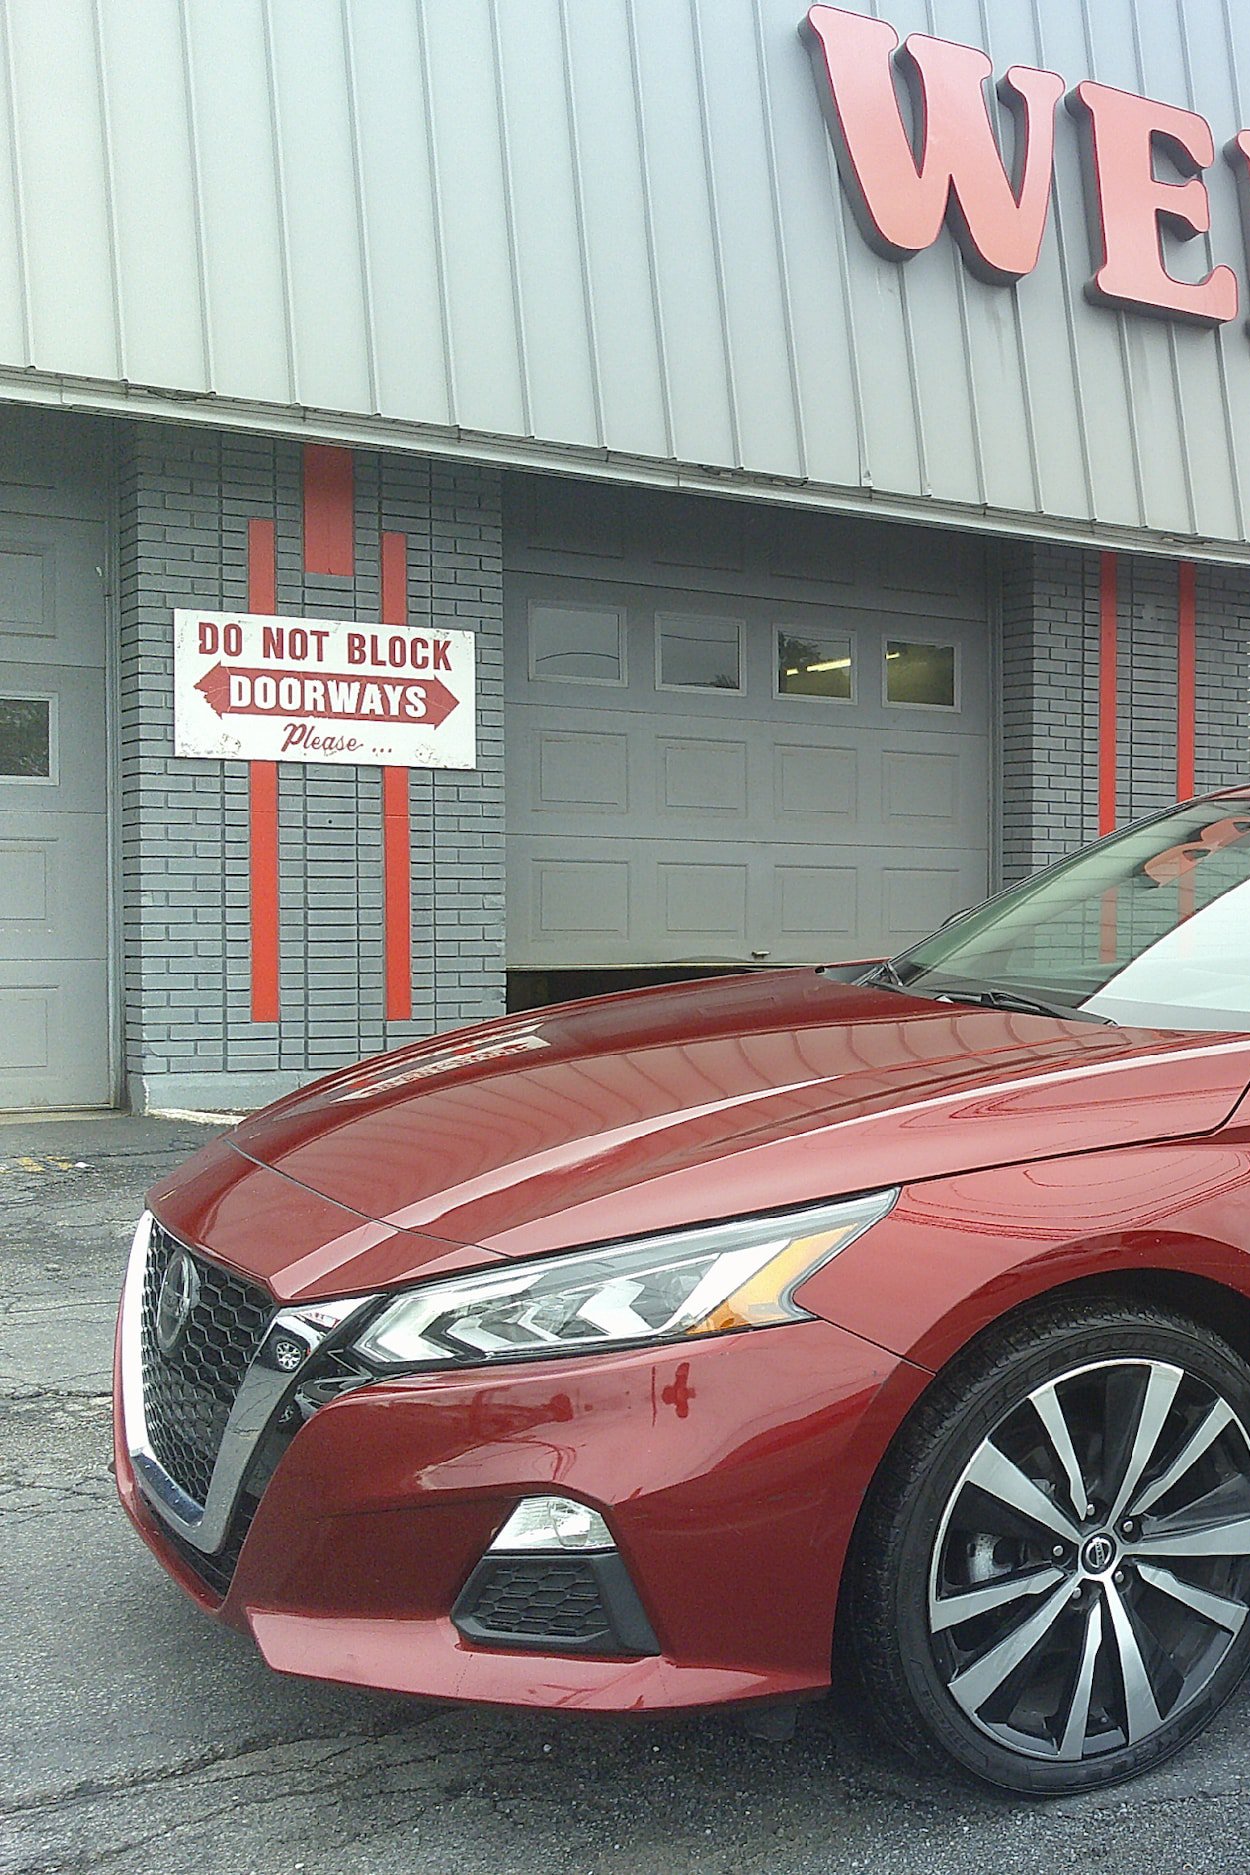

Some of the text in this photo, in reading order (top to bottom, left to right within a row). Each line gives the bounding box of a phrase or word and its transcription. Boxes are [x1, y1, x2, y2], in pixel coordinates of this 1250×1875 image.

[198, 622, 453, 671] DO NOT BLOCK
[229, 674, 428, 718] DOORWAYS
[281, 723, 364, 752] Please
